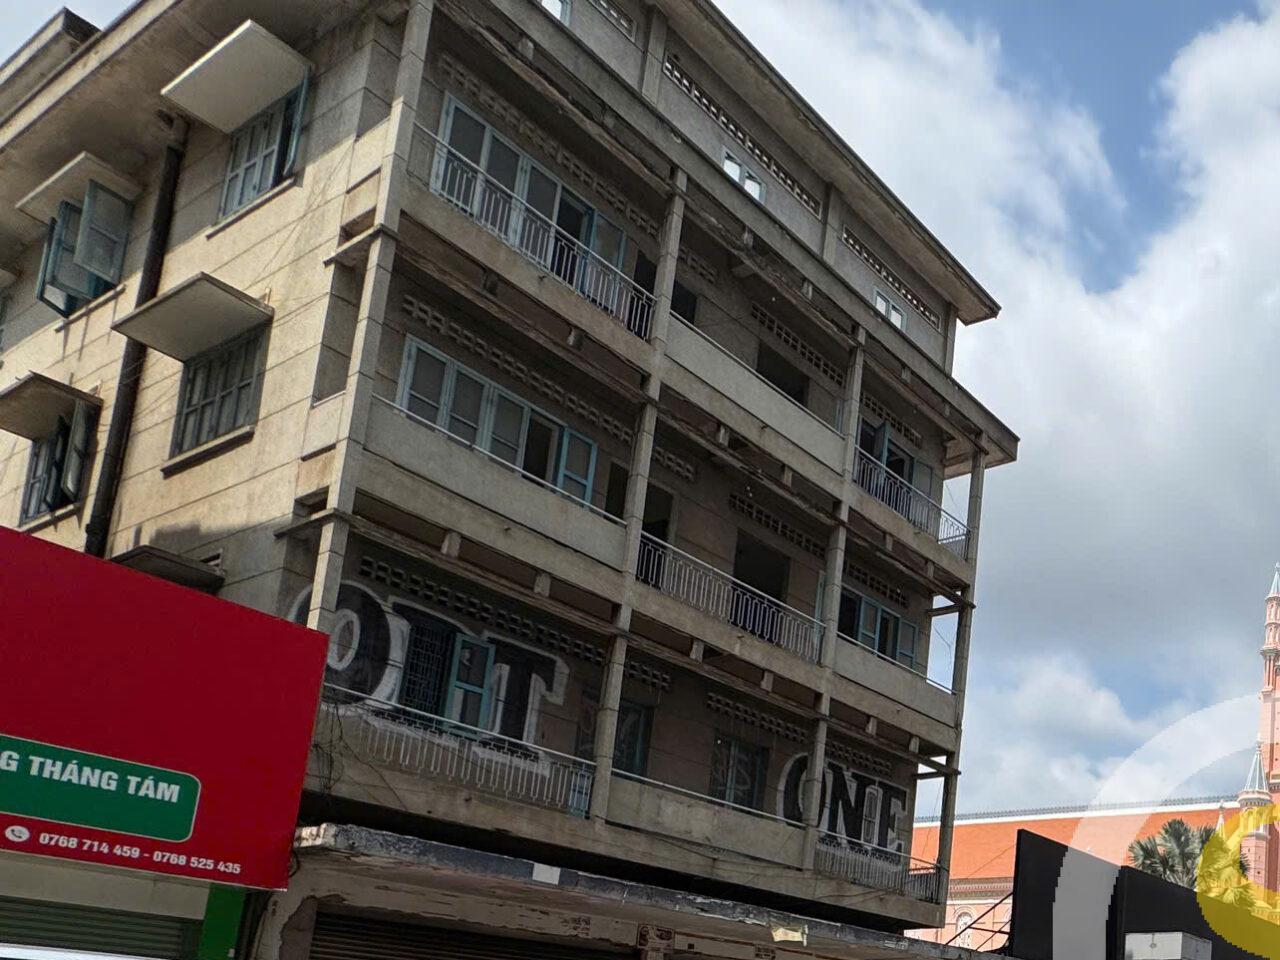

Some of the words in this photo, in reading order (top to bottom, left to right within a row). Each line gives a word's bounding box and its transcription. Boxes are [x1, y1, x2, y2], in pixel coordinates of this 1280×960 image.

[28, 755, 119, 792] THÁNG
[126, 774, 181, 803] TÁM
[39, 832, 79, 849] 0768
[82, 838, 109, 854] 714
[113, 842, 140, 859] 459
[153, 850, 186, 866] 0768
[190, 853, 215, 870] 525
[217, 859, 241, 874] 435
